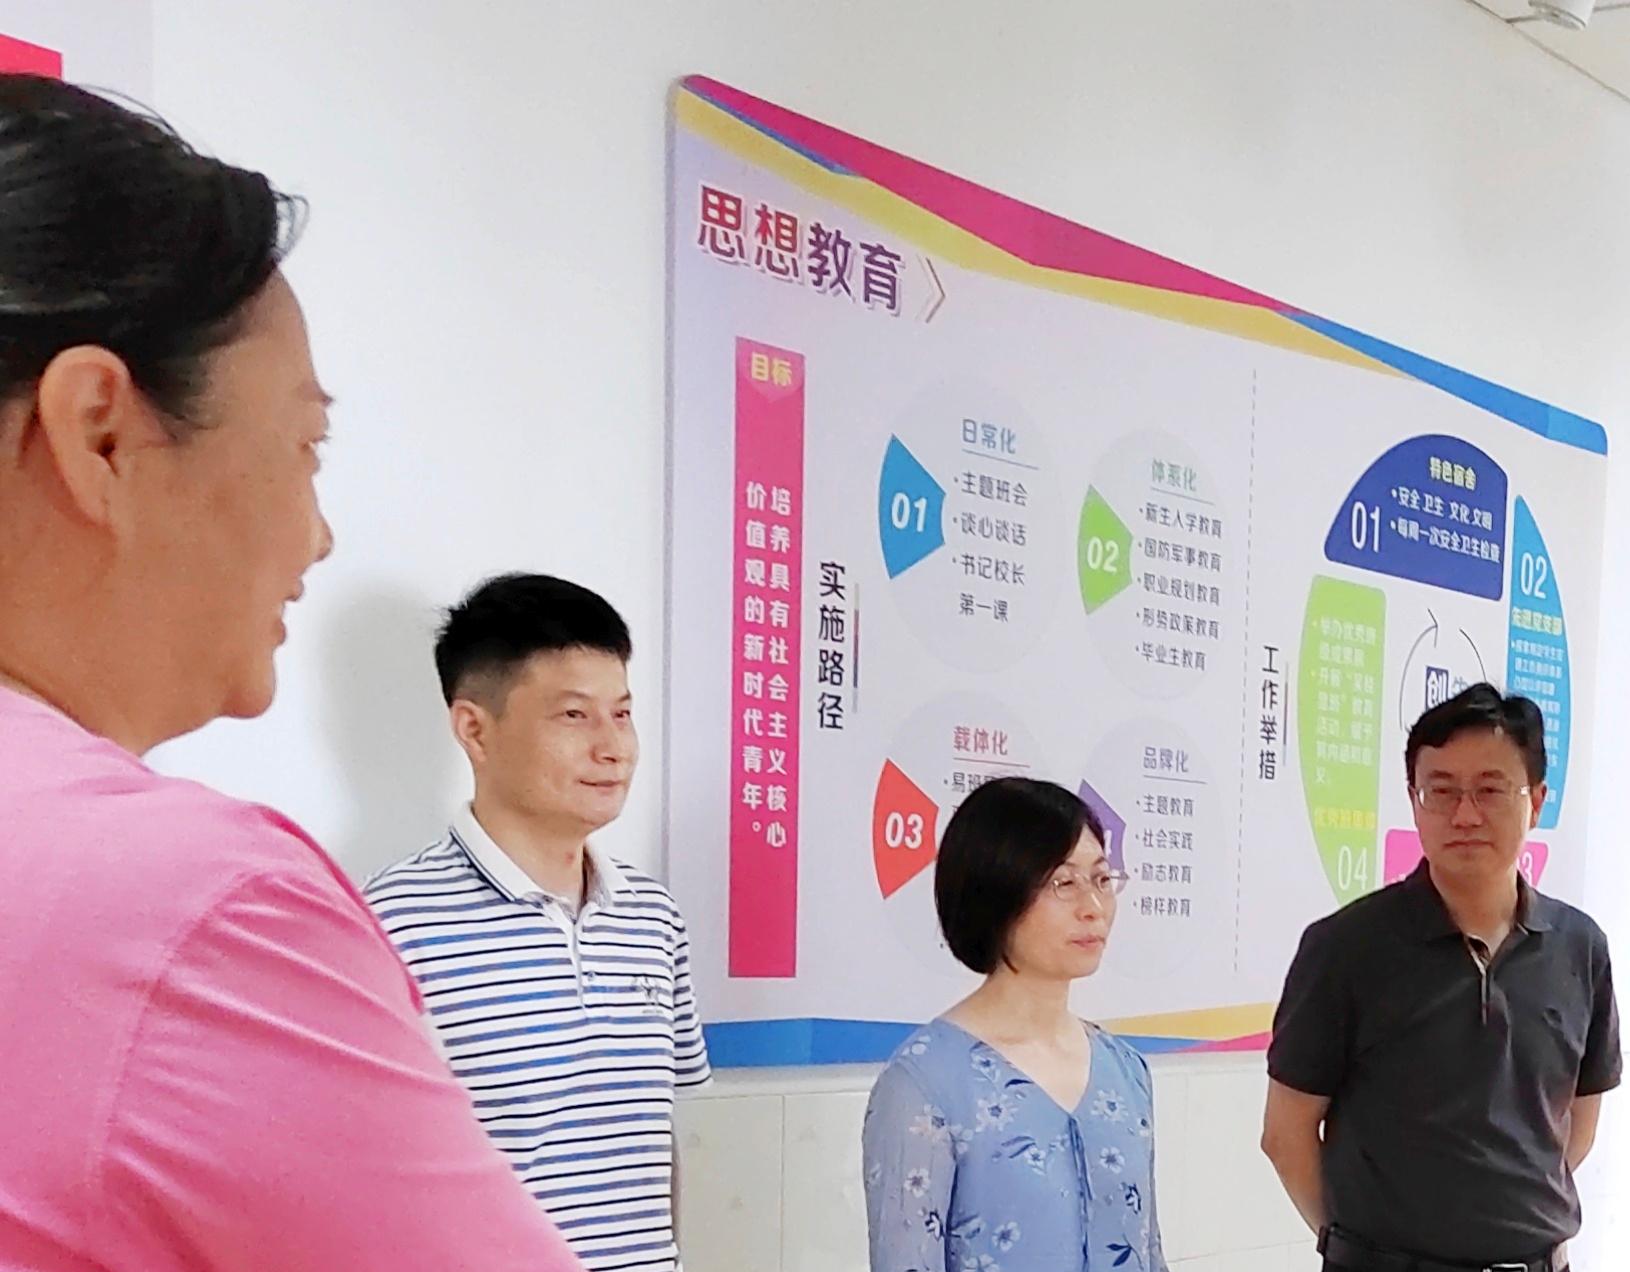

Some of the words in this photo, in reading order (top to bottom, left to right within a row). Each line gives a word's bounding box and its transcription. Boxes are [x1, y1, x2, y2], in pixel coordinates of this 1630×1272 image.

[697, 186, 902, 313] 思想教育
[751, 354, 793, 386] 目标
[962, 418, 1017, 454] 日常化
[961, 471, 1028, 507] 主题班会
[1152, 458, 1197, 492] 体系化
[890, 492, 927, 533] 01
[960, 512, 1027, 547] 谈心谈话
[1351, 500, 1382, 553] 01
[959, 554, 1025, 587] 书记校长
[1087, 536, 1119, 573] 02
[1144, 537, 1222, 572] 国防军事教育
[1143, 572, 1220, 607] 职业规划教育
[1520, 552, 1547, 599] 02
[959, 593, 1009, 623] 第一课
[1142, 607, 1219, 640] 形势政策教育
[817, 560, 846, 731] 实施路径
[766, 485, 791, 848] 培养具有社会主义核心
[1259, 644, 1280, 781] 工作举措
[953, 725, 1008, 757] 载体化
[1143, 746, 1190, 773] 品牌化
[1143, 794, 1195, 818] 主题教育
[885, 811, 924, 849] 03
[1142, 828, 1193, 851] 社会实践
[1338, 845, 1368, 891] 04
